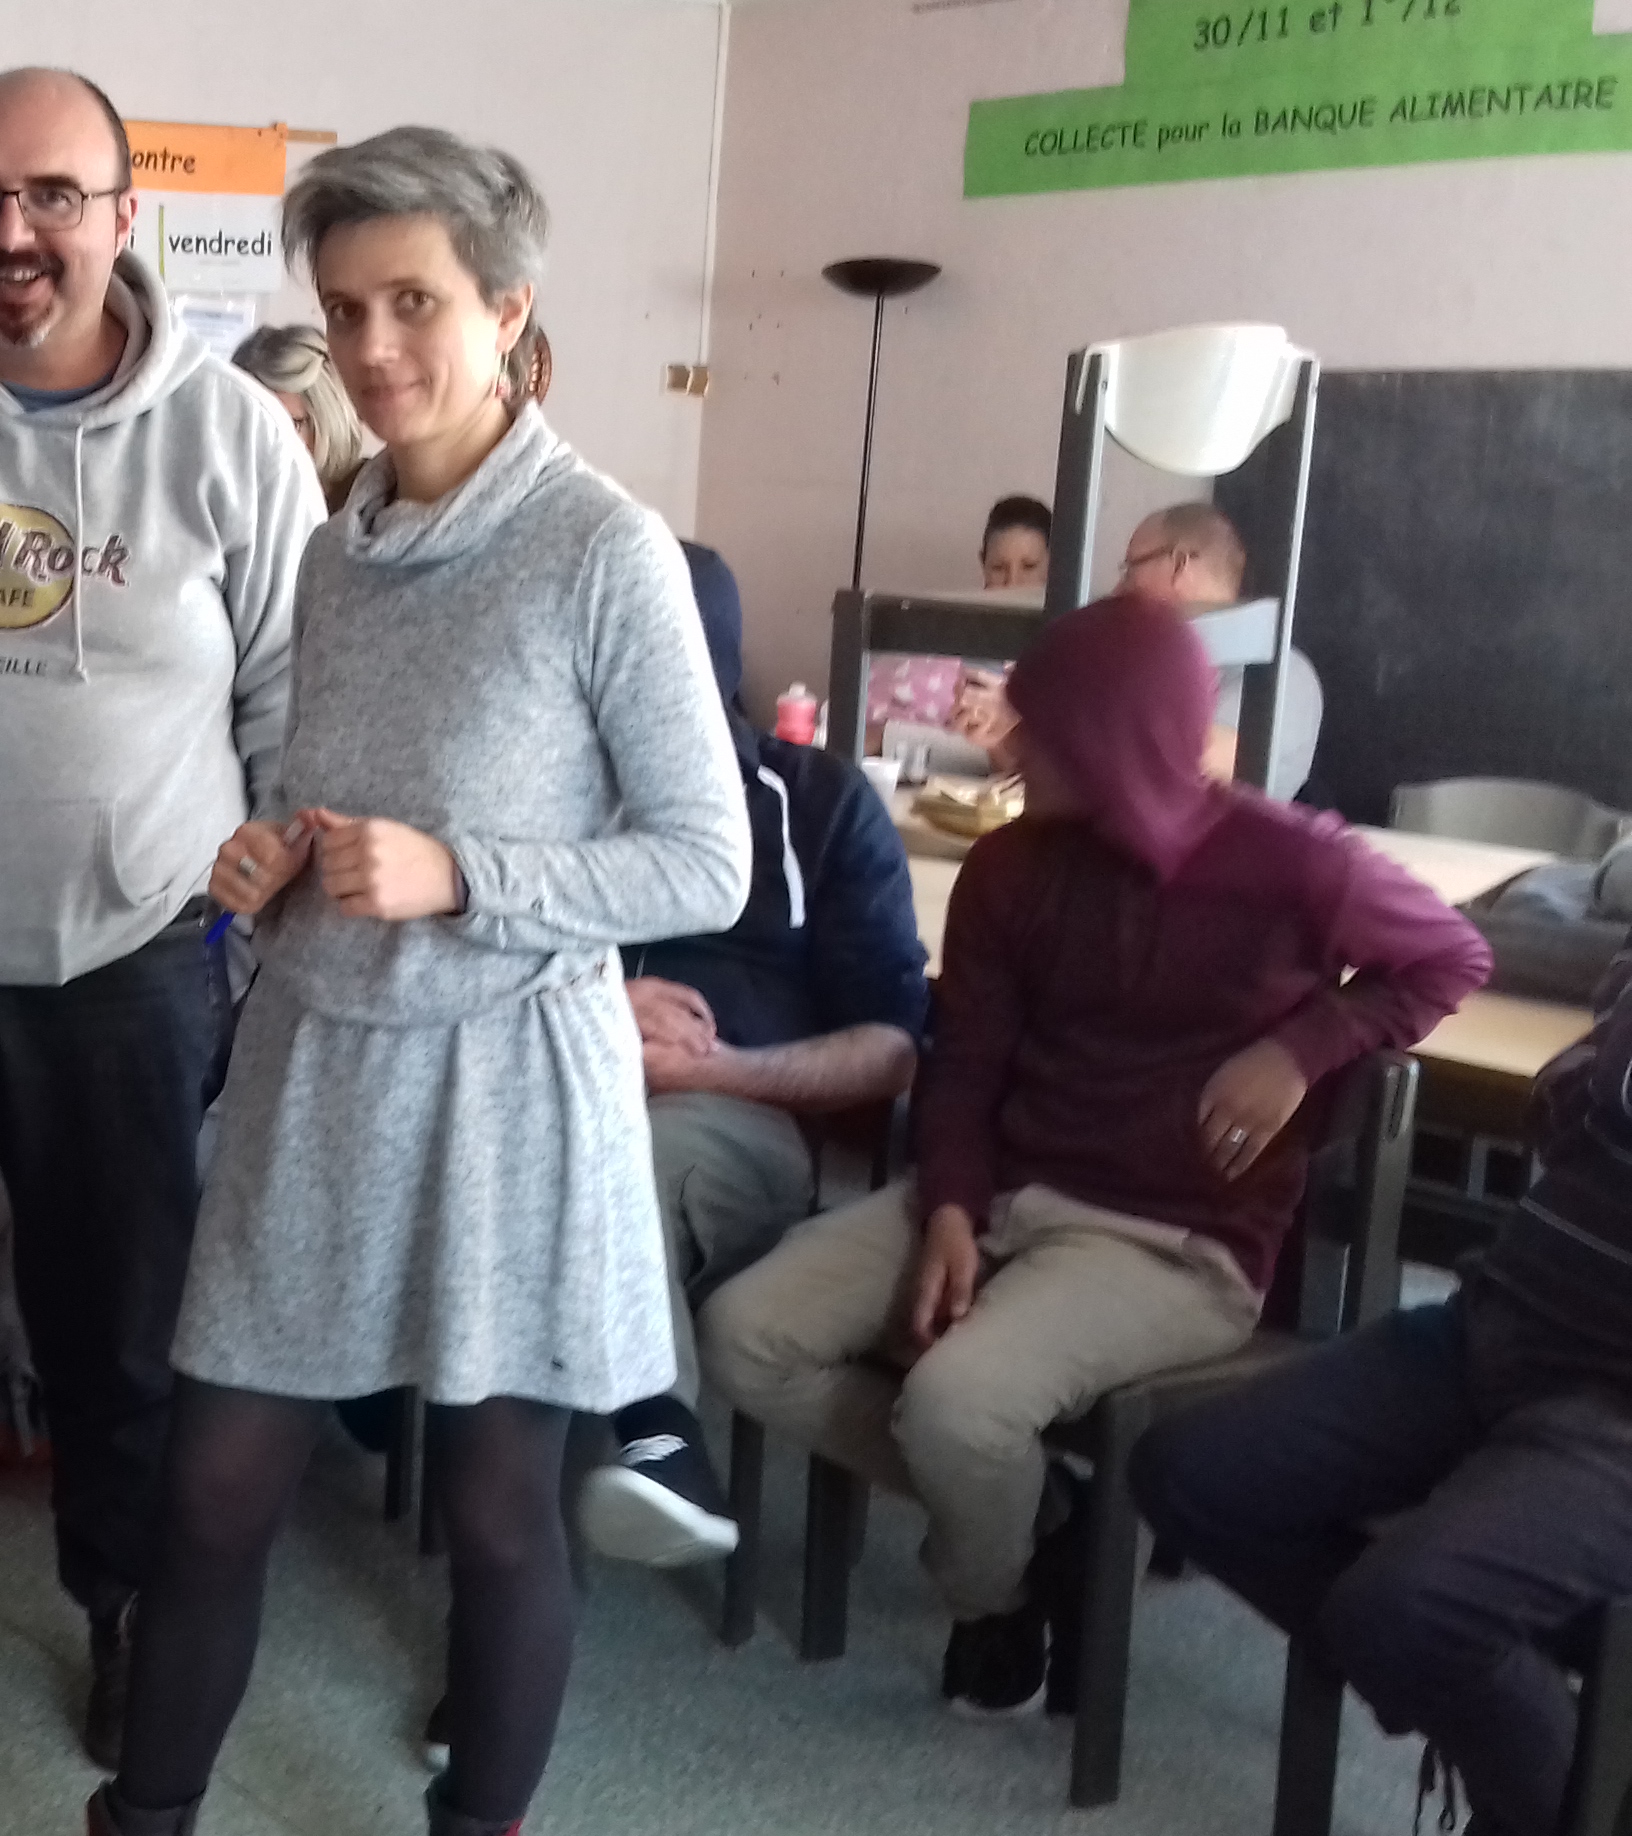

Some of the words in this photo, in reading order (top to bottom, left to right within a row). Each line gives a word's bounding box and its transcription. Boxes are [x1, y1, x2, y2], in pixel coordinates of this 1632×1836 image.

[1193, 9, 1289, 50] 30/11
[1308, 3, 1342, 33] et
[1024, 118, 1148, 157] COLLECTE
[1157, 121, 1209, 153] pour
[1220, 114, 1241, 140] la
[1254, 95, 1375, 137] BANQUE
[1389, 76, 1618, 124] ALIMENTAIRE
[168, 227, 273, 257] vendredi
[11, 527, 131, 587] Rock
